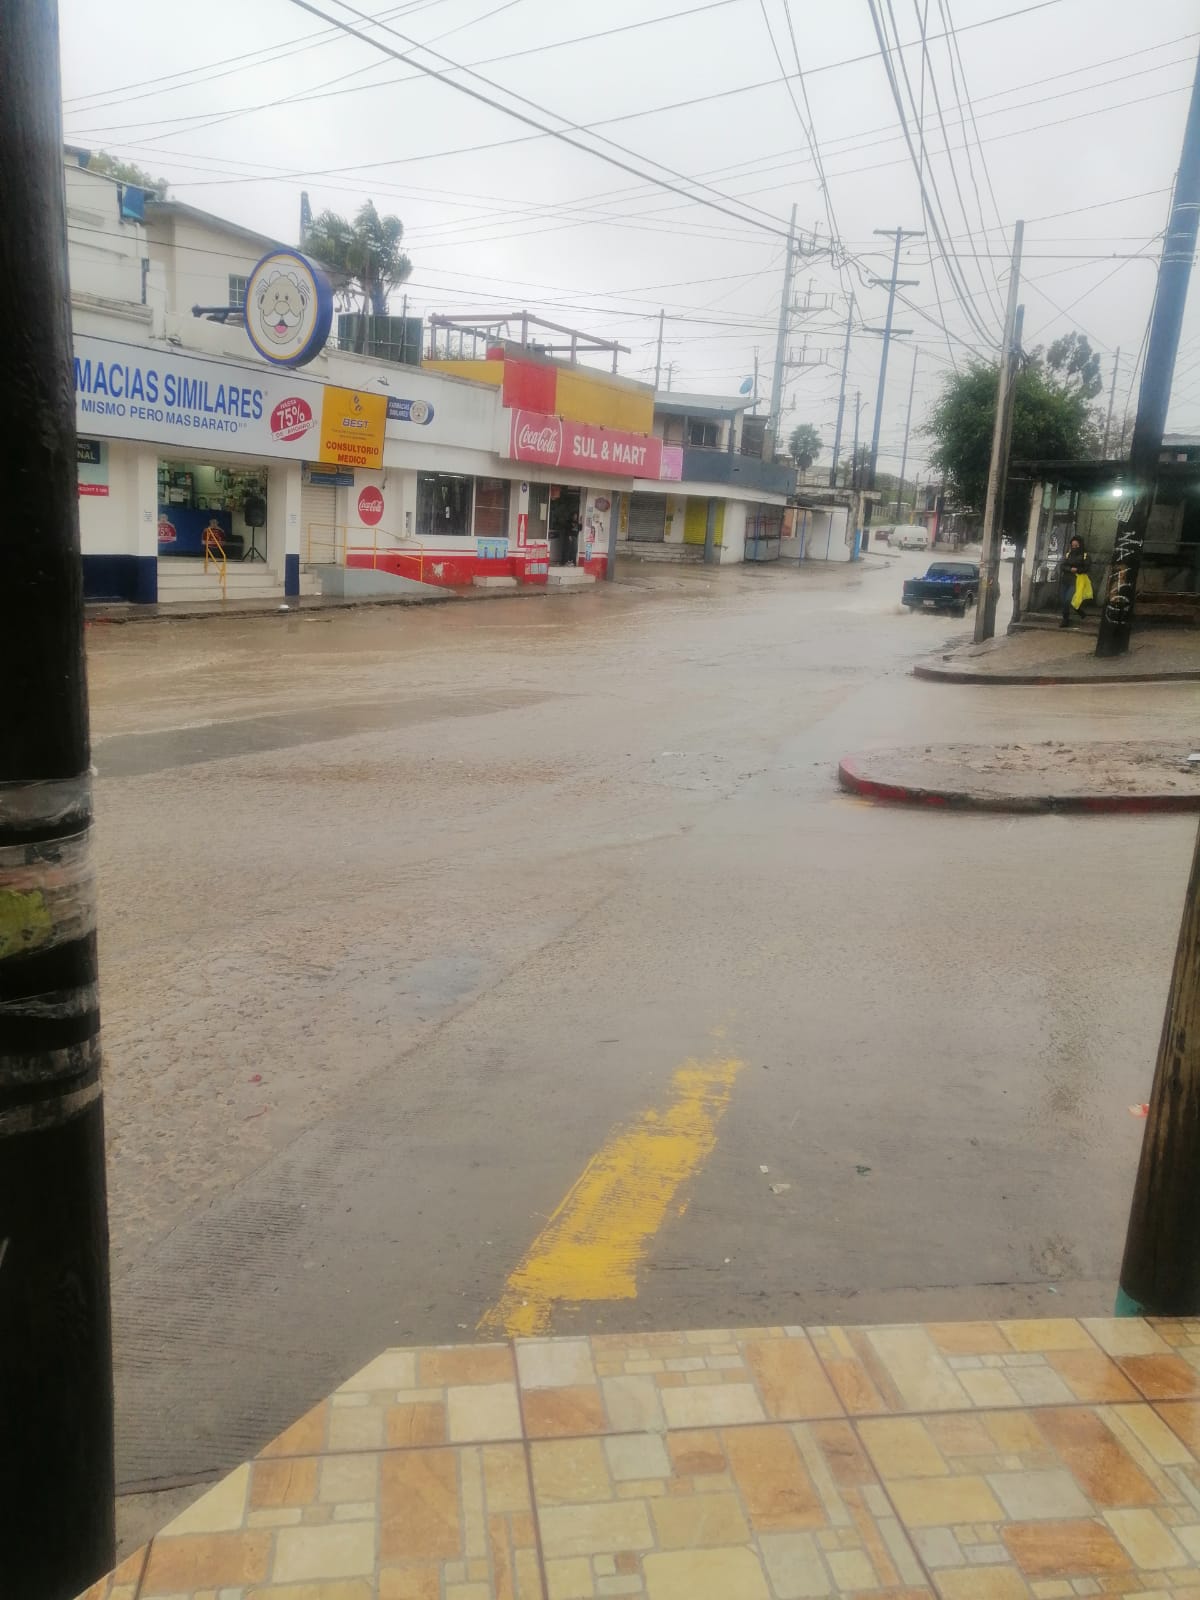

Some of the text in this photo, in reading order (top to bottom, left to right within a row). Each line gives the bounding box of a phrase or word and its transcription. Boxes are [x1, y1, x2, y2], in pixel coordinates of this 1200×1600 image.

[164, 374, 263, 420] SIMILARES
[81, 399, 239, 433] MISMO PERO MAS BARATO
[276, 404, 305, 429] 75%
[342, 418, 369, 428] BEST
[326, 441, 380, 456] CONSULTORIO
[519, 424, 559, 454] Coca-Cola
[573, 435, 598, 459] SUL
[601, 441, 609, 459] &
[613, 443, 647, 466] MART
[337, 454, 367, 465] MEDICO
